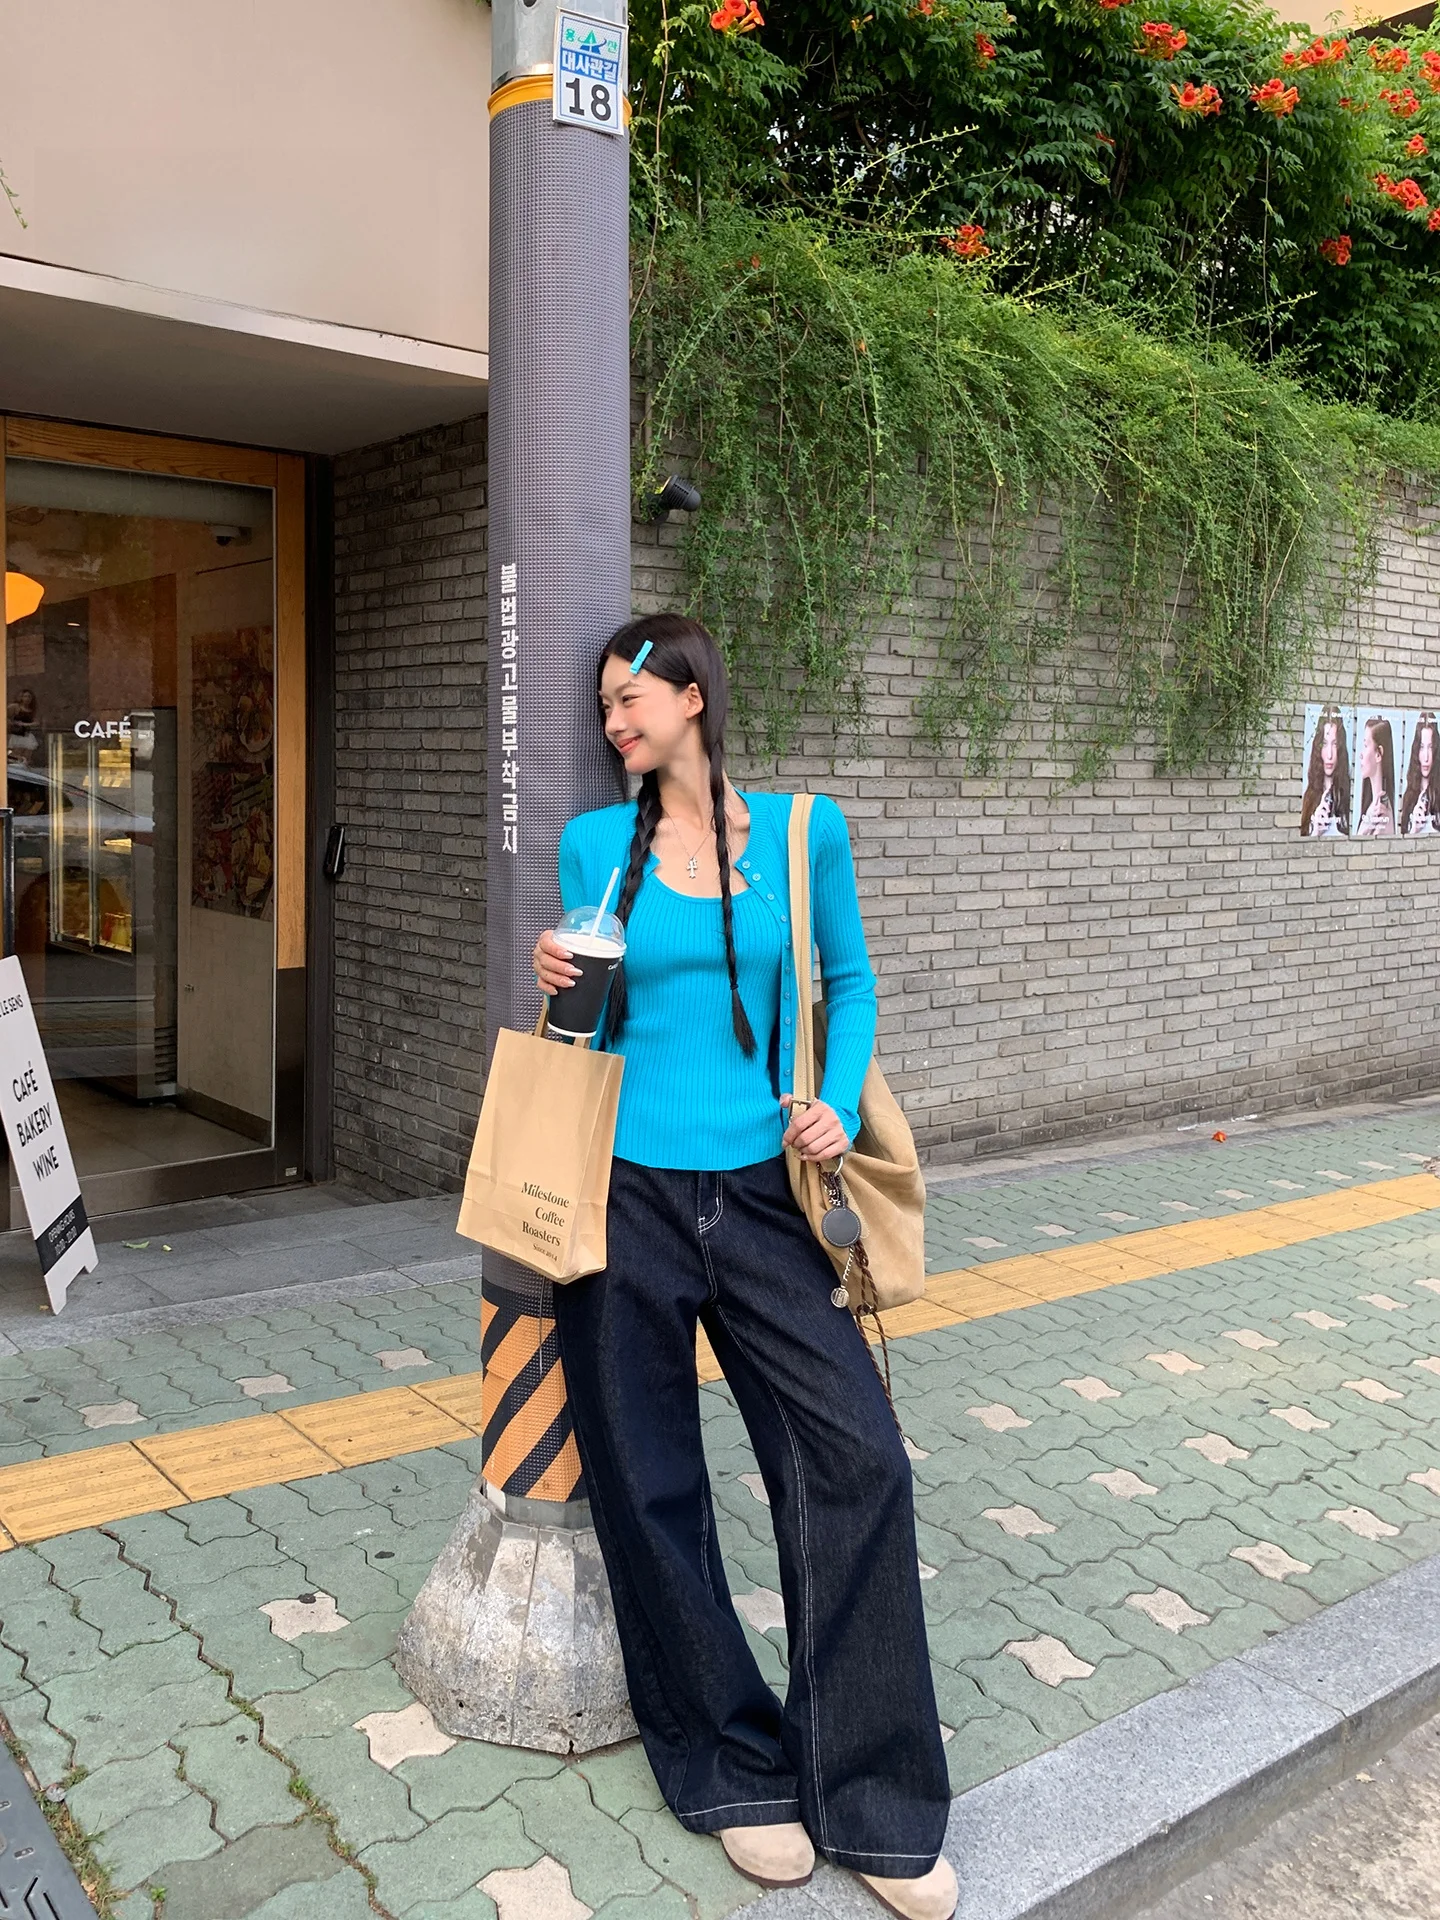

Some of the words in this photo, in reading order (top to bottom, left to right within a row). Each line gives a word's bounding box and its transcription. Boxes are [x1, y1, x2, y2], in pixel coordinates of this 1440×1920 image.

[562, 50, 618, 82] 대사관길
[565, 77, 611, 121] 18
[74, 715, 131, 739] CAFÉ
[8, 994, 24, 1012] SENS
[12, 1060, 39, 1103] CAFÉ
[16, 1102, 53, 1148] BAKERY
[32, 1145, 60, 1182] WINE
[521, 1181, 570, 1208] Milestone
[535, 1206, 565, 1228] Coffee
[522, 1220, 561, 1247] Roasters
